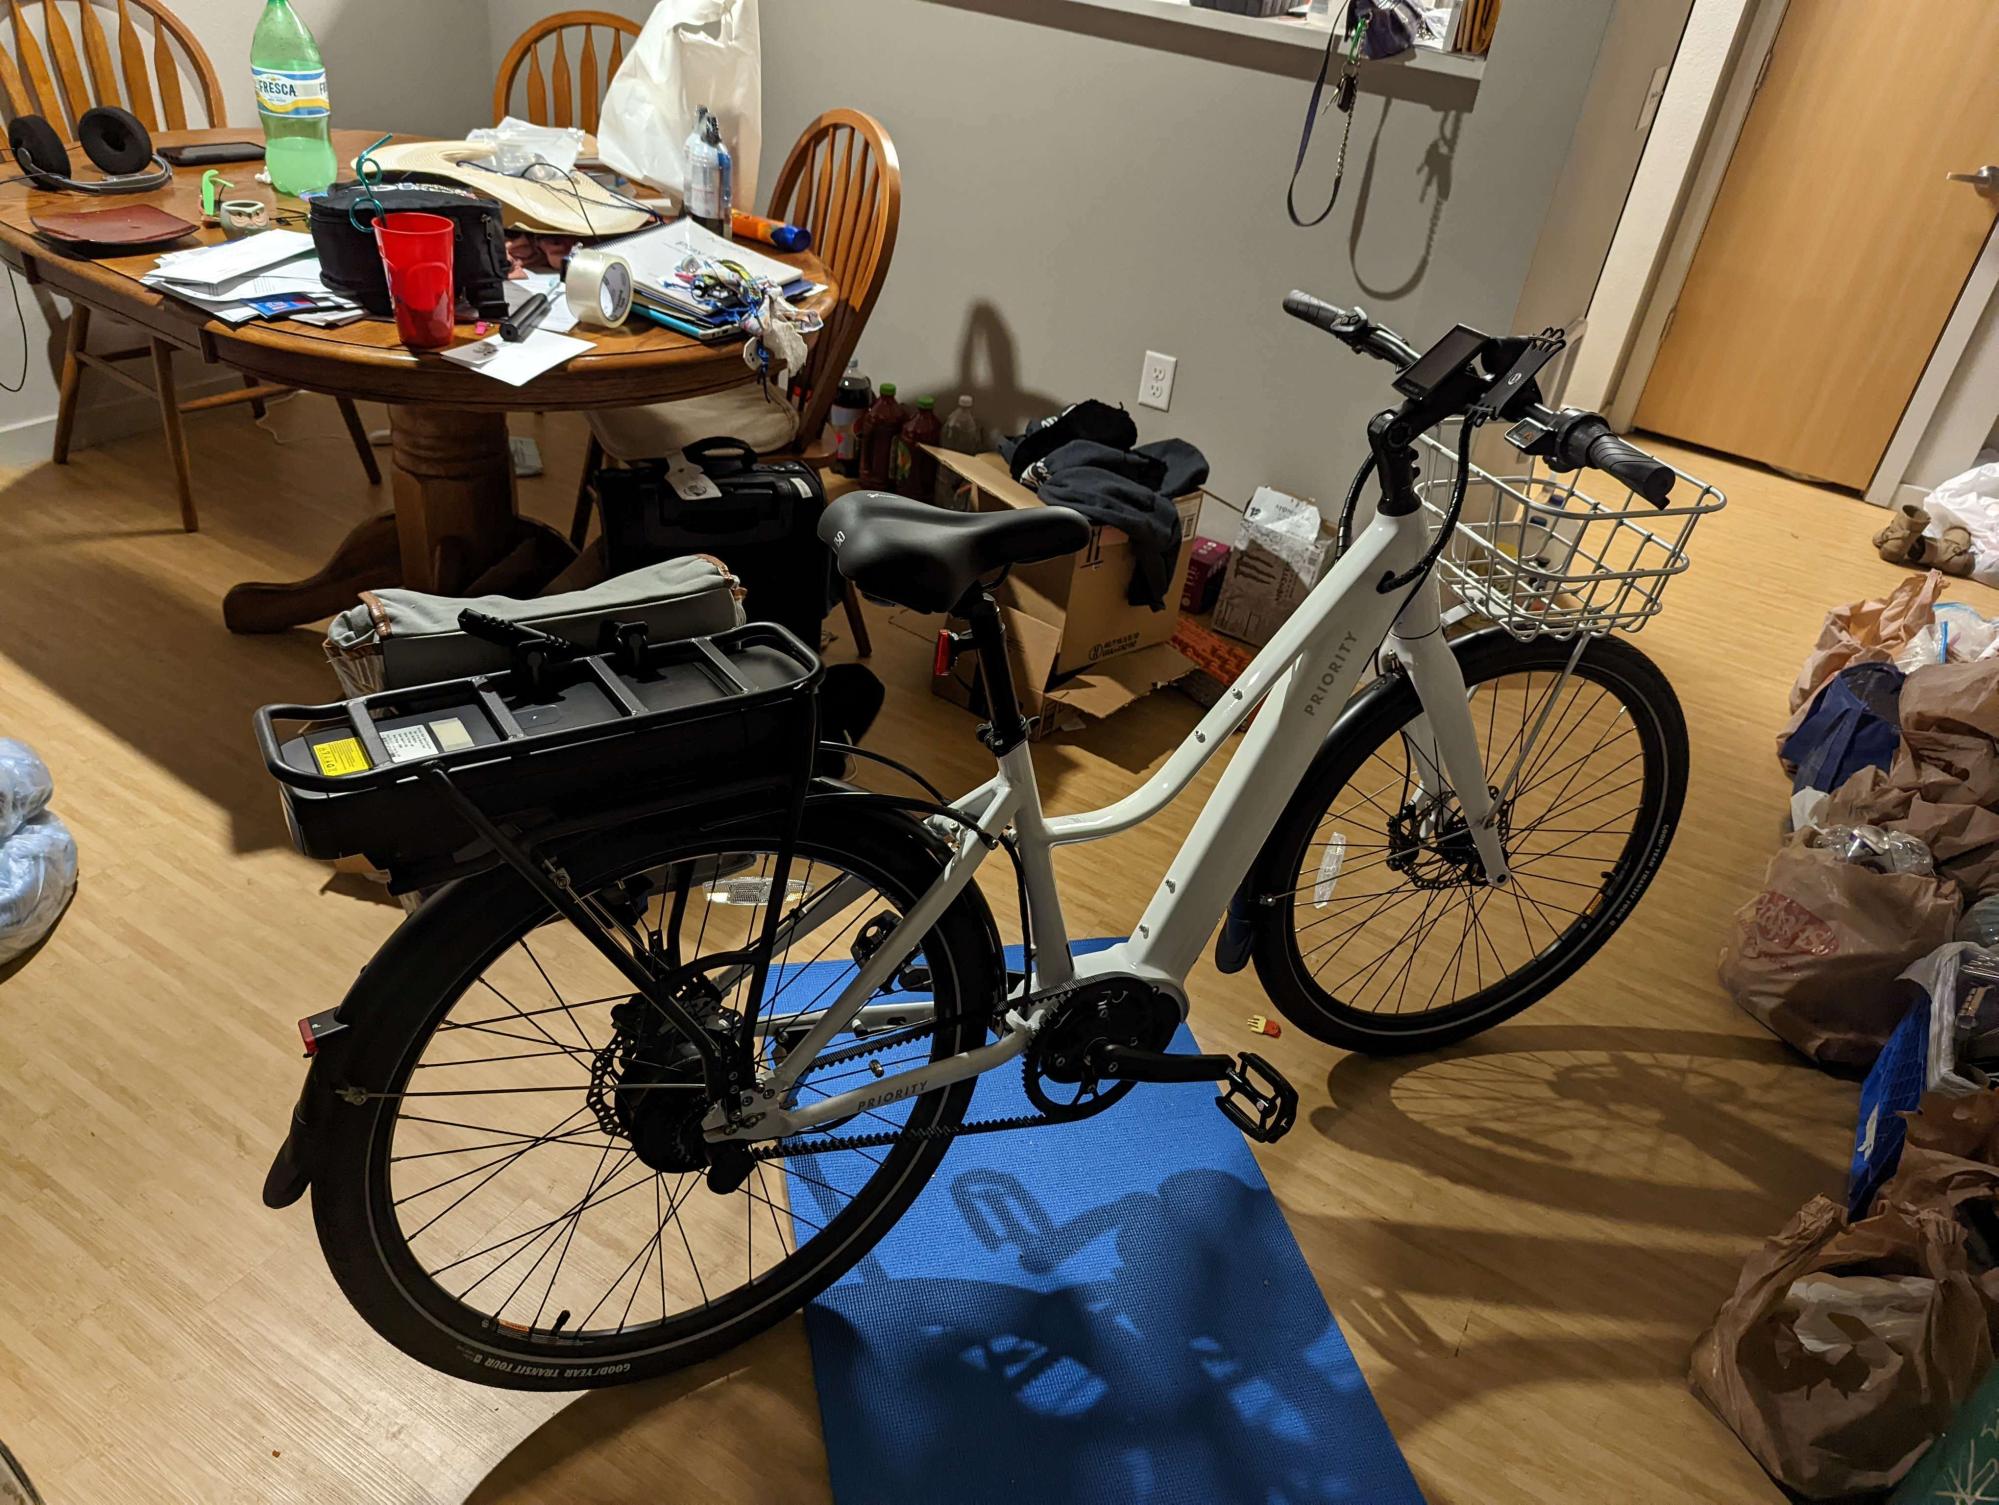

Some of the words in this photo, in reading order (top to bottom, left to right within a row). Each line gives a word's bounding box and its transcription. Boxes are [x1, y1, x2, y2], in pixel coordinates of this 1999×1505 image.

[259, 80, 297, 97] FRESCA
[1304, 631, 1357, 716] PRIORITY
[858, 1080, 928, 1112] PRIORITY
[484, 1357, 513, 1374] TOUR
[513, 1365, 559, 1378] TRANSIT
